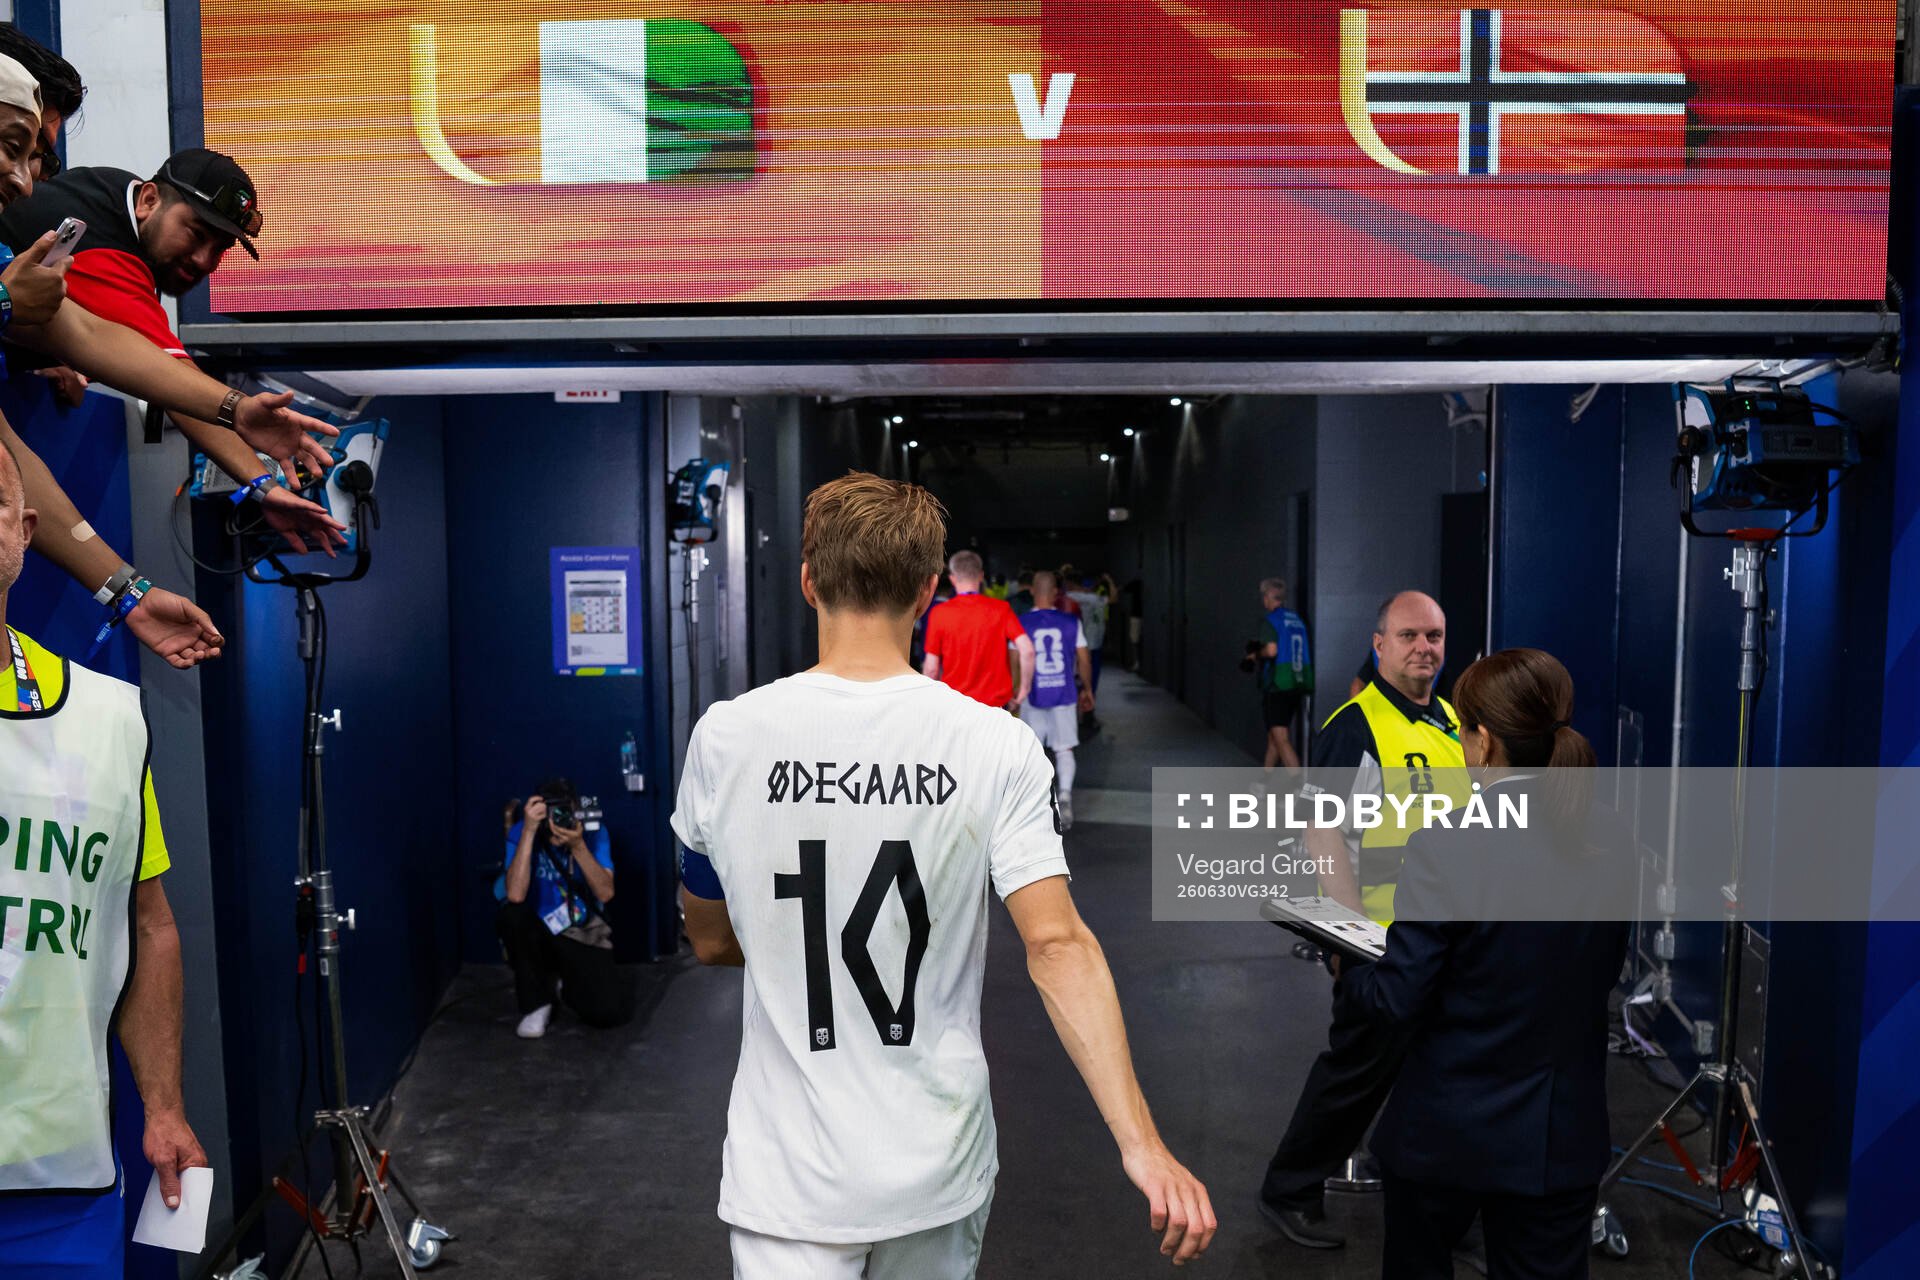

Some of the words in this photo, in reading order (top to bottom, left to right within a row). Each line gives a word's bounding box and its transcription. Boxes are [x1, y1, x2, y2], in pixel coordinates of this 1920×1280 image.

[767, 760, 957, 805] ØDEGAARD
[0, 816, 110, 883] ING
[774, 840, 931, 1052] 10
